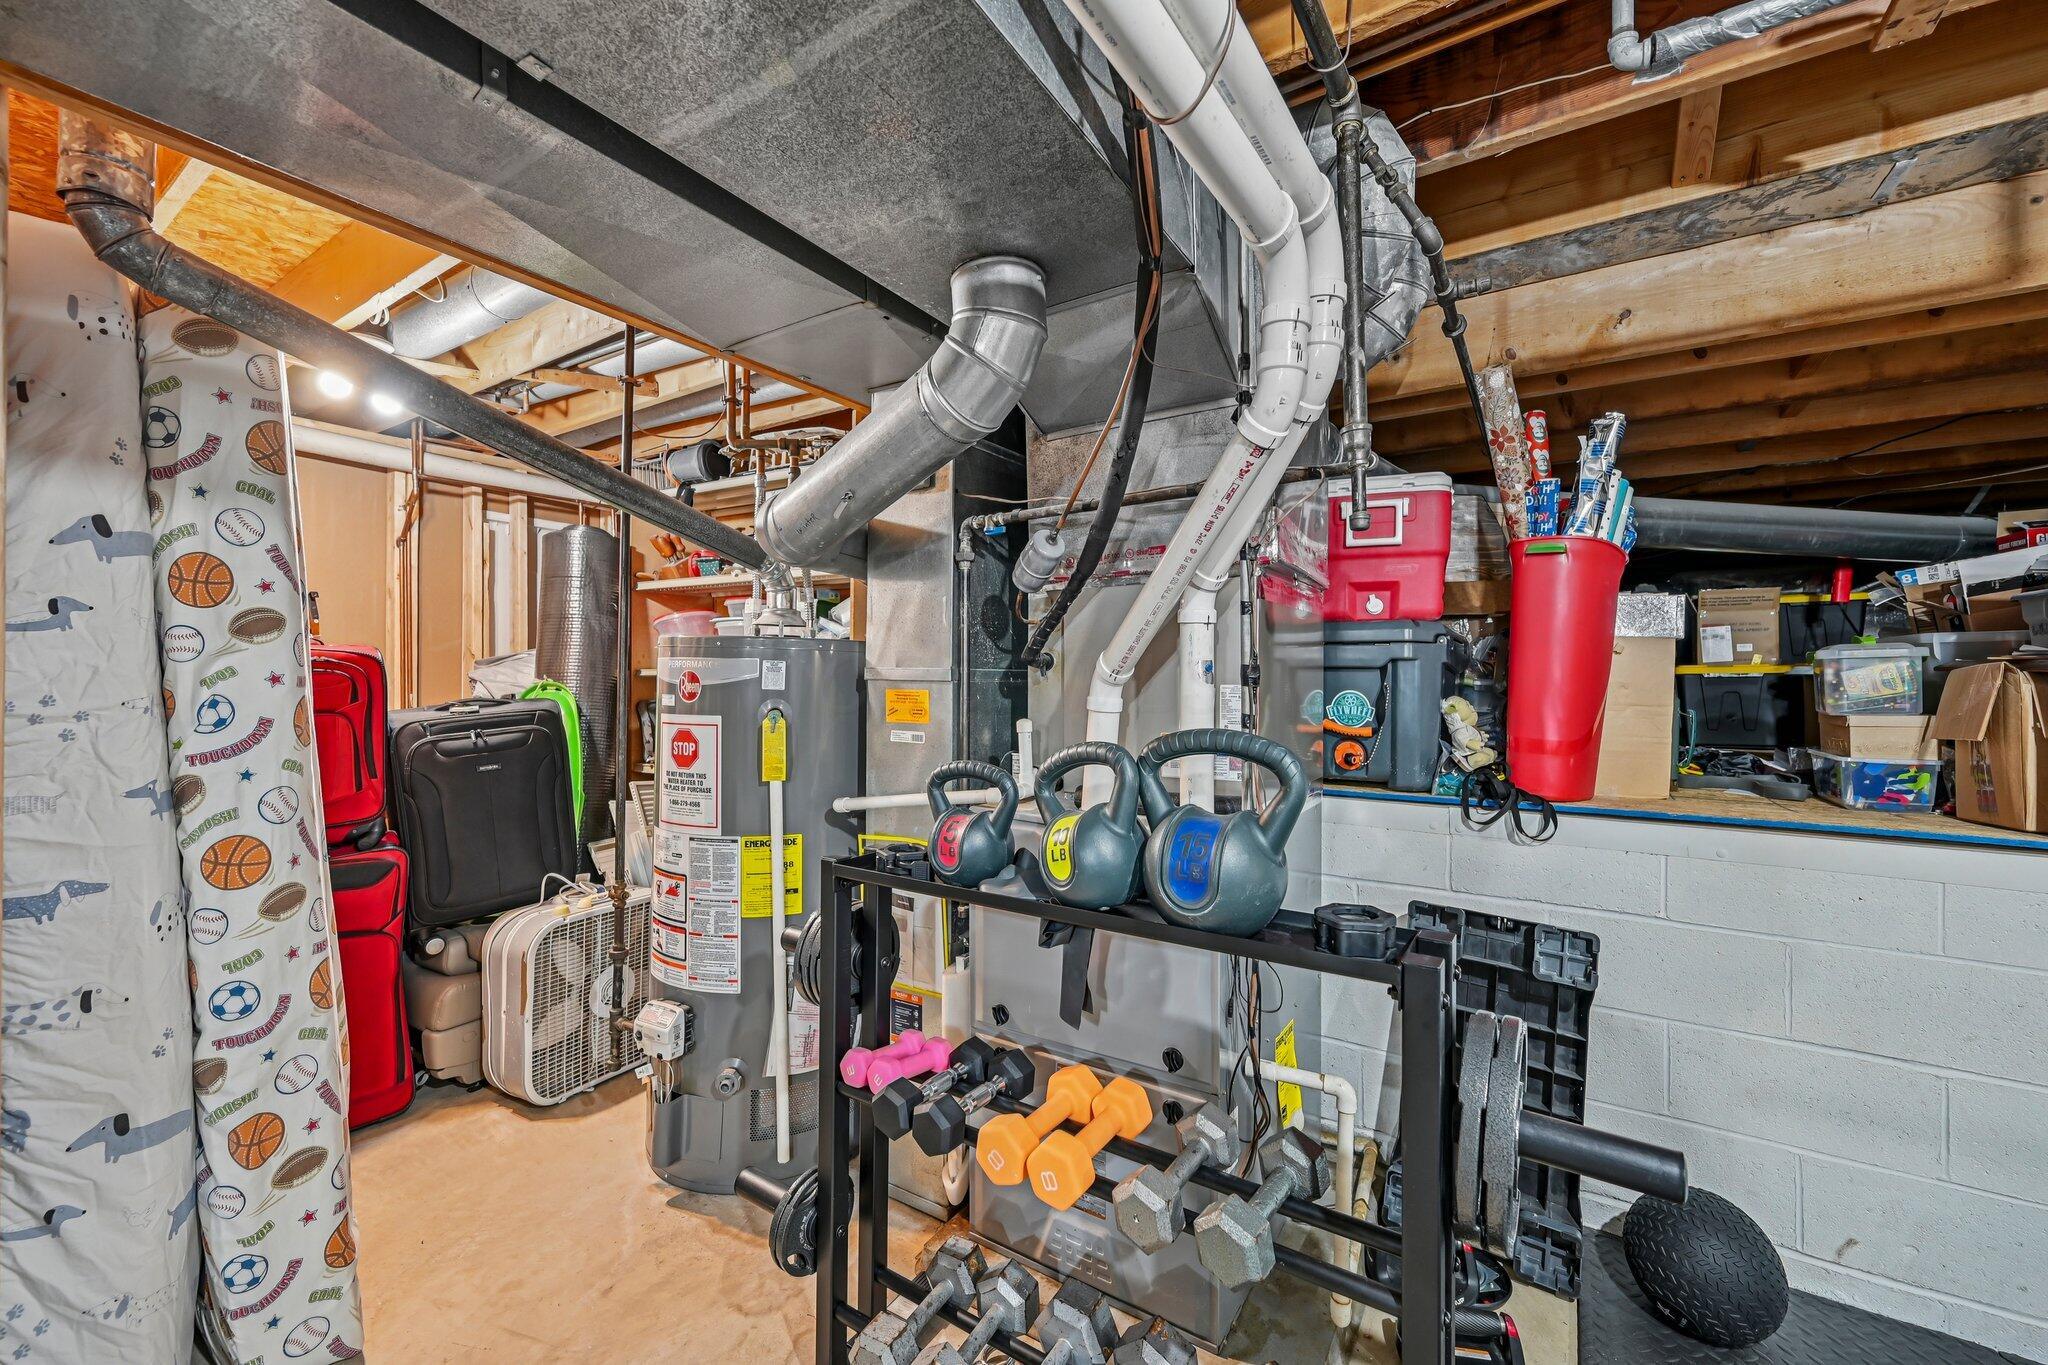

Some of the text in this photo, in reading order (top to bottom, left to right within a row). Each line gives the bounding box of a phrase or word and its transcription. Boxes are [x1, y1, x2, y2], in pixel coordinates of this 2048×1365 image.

[150, 432, 222, 480] OUCHDOWN
[235, 480, 276, 505] GOAL
[185, 716, 275, 768] TOUCHDOWN
[673, 742, 696, 756] STOP
[943, 818, 960, 844] 5
[1051, 825, 1070, 847] 10
[940, 845, 956, 858] LB
[1051, 848, 1067, 862] LB
[1180, 831, 1211, 860] 15
[1177, 860, 1204, 880] LB
[212, 994, 292, 1051] TOUCHDOWN
[987, 1150, 1005, 1170] 8
[1040, 1170, 1058, 1192] 8
[308, 1286, 343, 1304] GOAL
